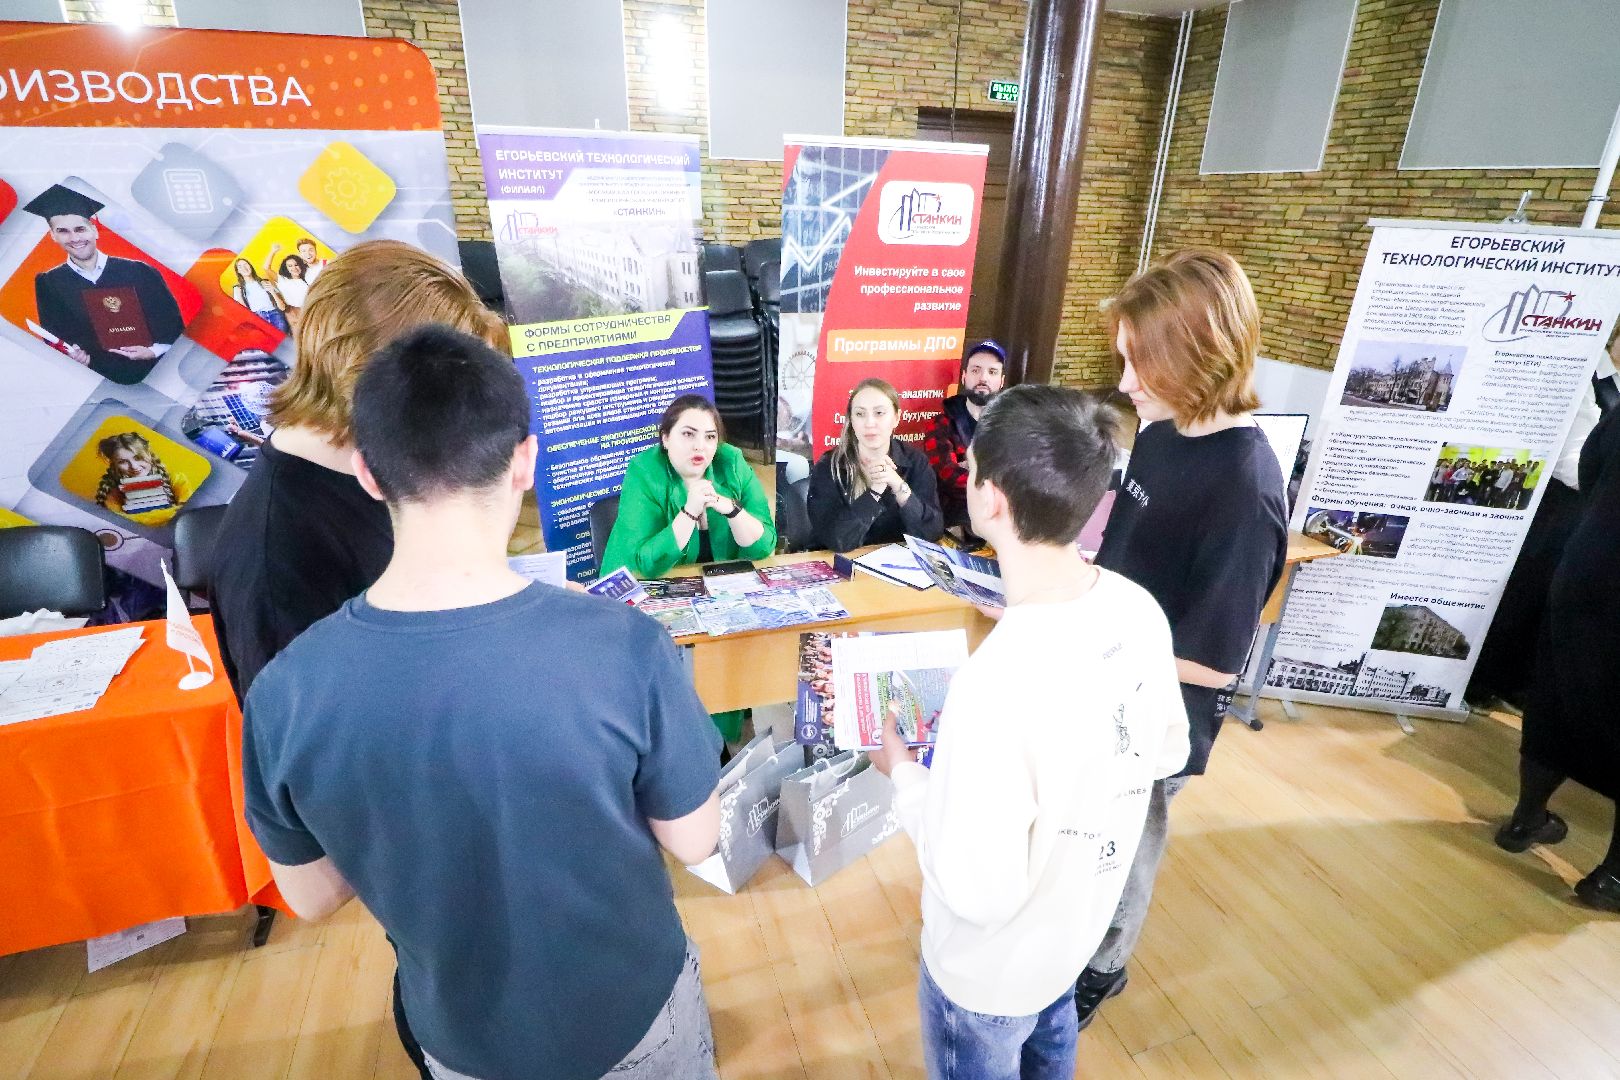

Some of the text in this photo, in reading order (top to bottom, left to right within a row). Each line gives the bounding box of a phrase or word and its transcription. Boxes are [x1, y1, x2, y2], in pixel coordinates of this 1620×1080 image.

[0, 69, 312, 111] ИЗВОДСТВА
[993, 83, 1019, 94] ВЫХО
[496, 149, 690, 166] ЕГОРЬЕВСКИЙ ТЕХНОЛОГИЧЕСКИЙ
[498, 168, 563, 180] ИНСТИТУТ
[500, 184, 545, 195] (ФИЛИАЛ)
[911, 214, 962, 225] СТАНКИН
[1451, 236, 1566, 254] ЕГОРЬЕВСКИЙ
[854, 265, 966, 279] Инвестируйте в свое
[1382, 252, 1620, 277] ТЕХНОЛОГИЧЕСКИЙ ИНСТИТУТ
[859, 282, 964, 297] профессиональное
[913, 301, 962, 313] развитие
[524, 314, 672, 339] ФОРМЫ СОТРУДНИЧЕСТВА
[1521, 314, 1603, 332] СТАНКИН
[526, 330, 637, 352] С ПРЕДПРИЯТИЯМИ
[834, 336, 919, 355] Программы
[923, 335, 957, 353] ДПО
[532, 358, 605, 373] ТЕХНОЛОГИЧЕСКАЯ
[606, 351, 649, 363] ПОДДЕРЖКА
[896, 389, 944, 399] -аналитик
[612, 431, 660, 447] ПРОИЗВОДСТВ
[1311, 494, 1343, 505] Формы
[1344, 498, 1387, 509] обучения:
[1390, 592, 1429, 603] Имеется
[1430, 596, 1486, 610] общежитие
